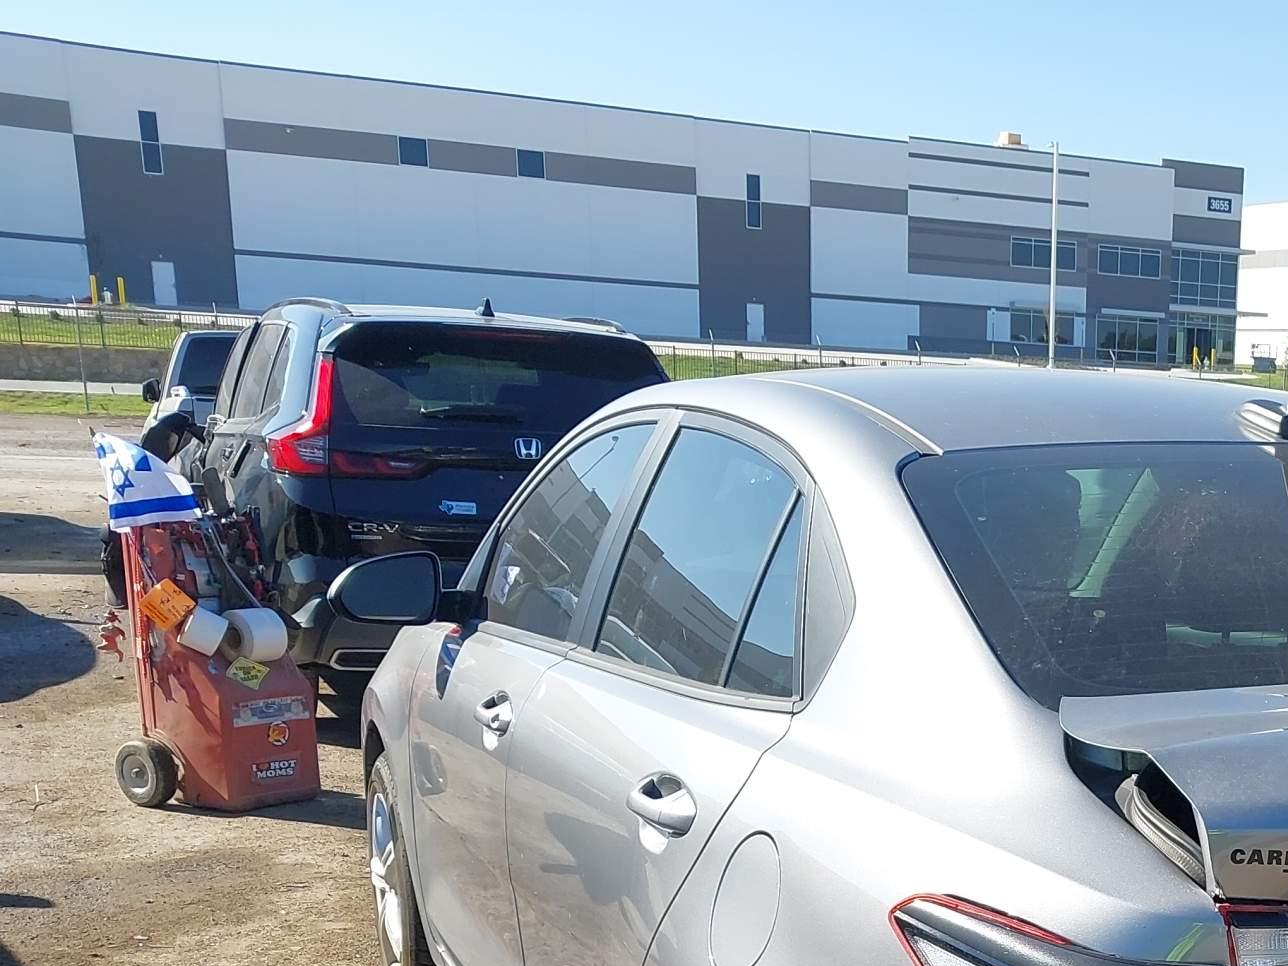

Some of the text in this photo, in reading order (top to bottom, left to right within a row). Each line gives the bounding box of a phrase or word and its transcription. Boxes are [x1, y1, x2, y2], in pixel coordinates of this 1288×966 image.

[348, 522, 399, 533] CR-V
[270, 760, 297, 769] HOT
[257, 768, 294, 779] MOMS
